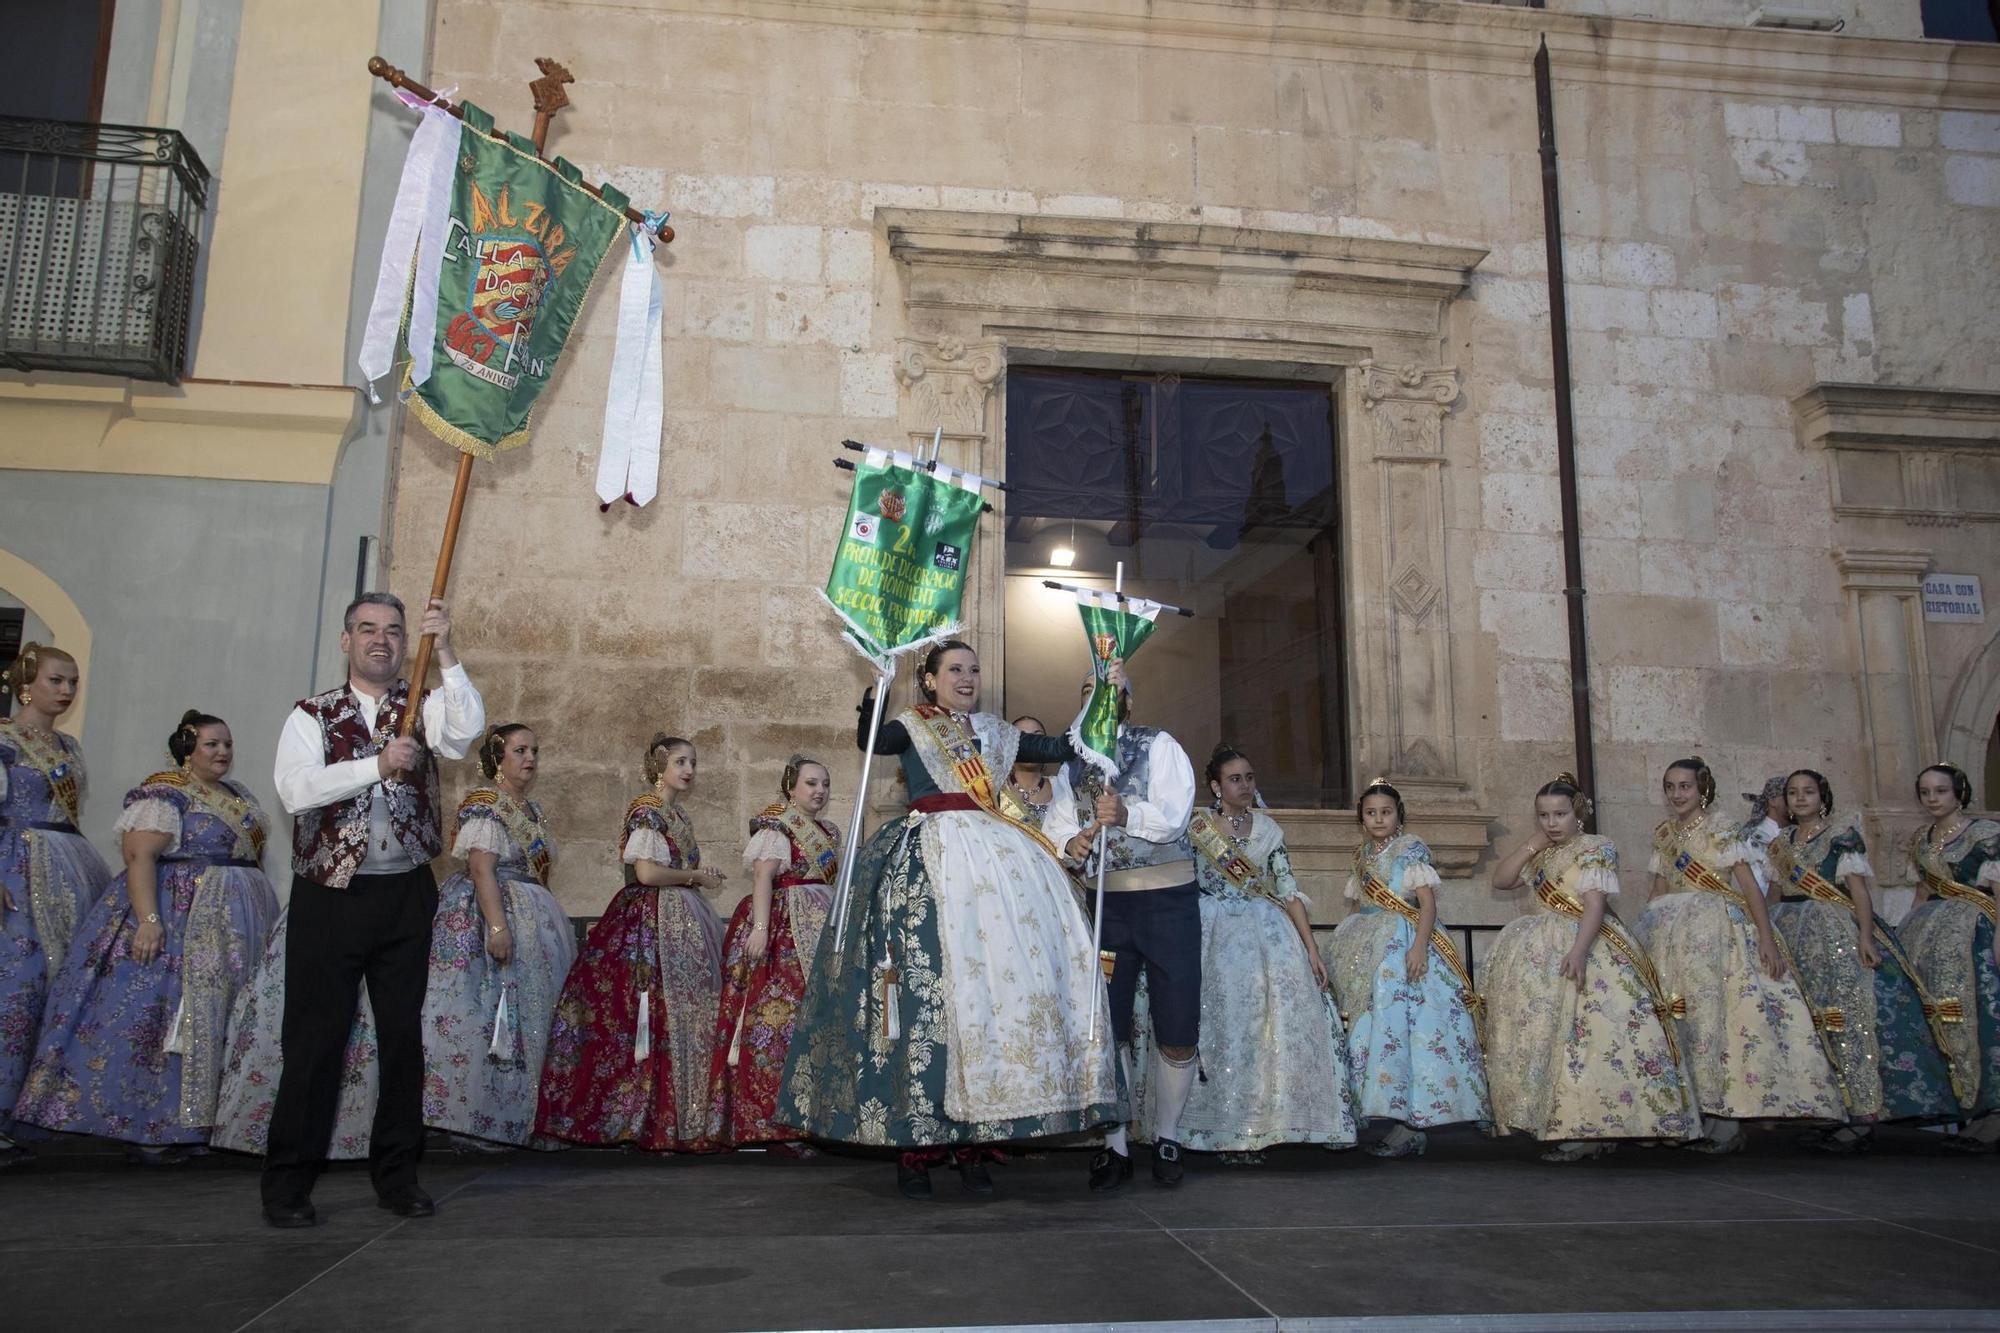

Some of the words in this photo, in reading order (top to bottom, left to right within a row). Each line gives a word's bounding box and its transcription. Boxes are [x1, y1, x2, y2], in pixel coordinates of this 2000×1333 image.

[471, 180, 580, 279] ALZIRA
[442, 215, 524, 270] FALLA
[459, 359, 476, 371] 75
[880, 552, 898, 572] DE
[858, 566, 877, 587] DE
[1926, 583, 1952, 595] CASA
[888, 602, 950, 632] PRIMERA
